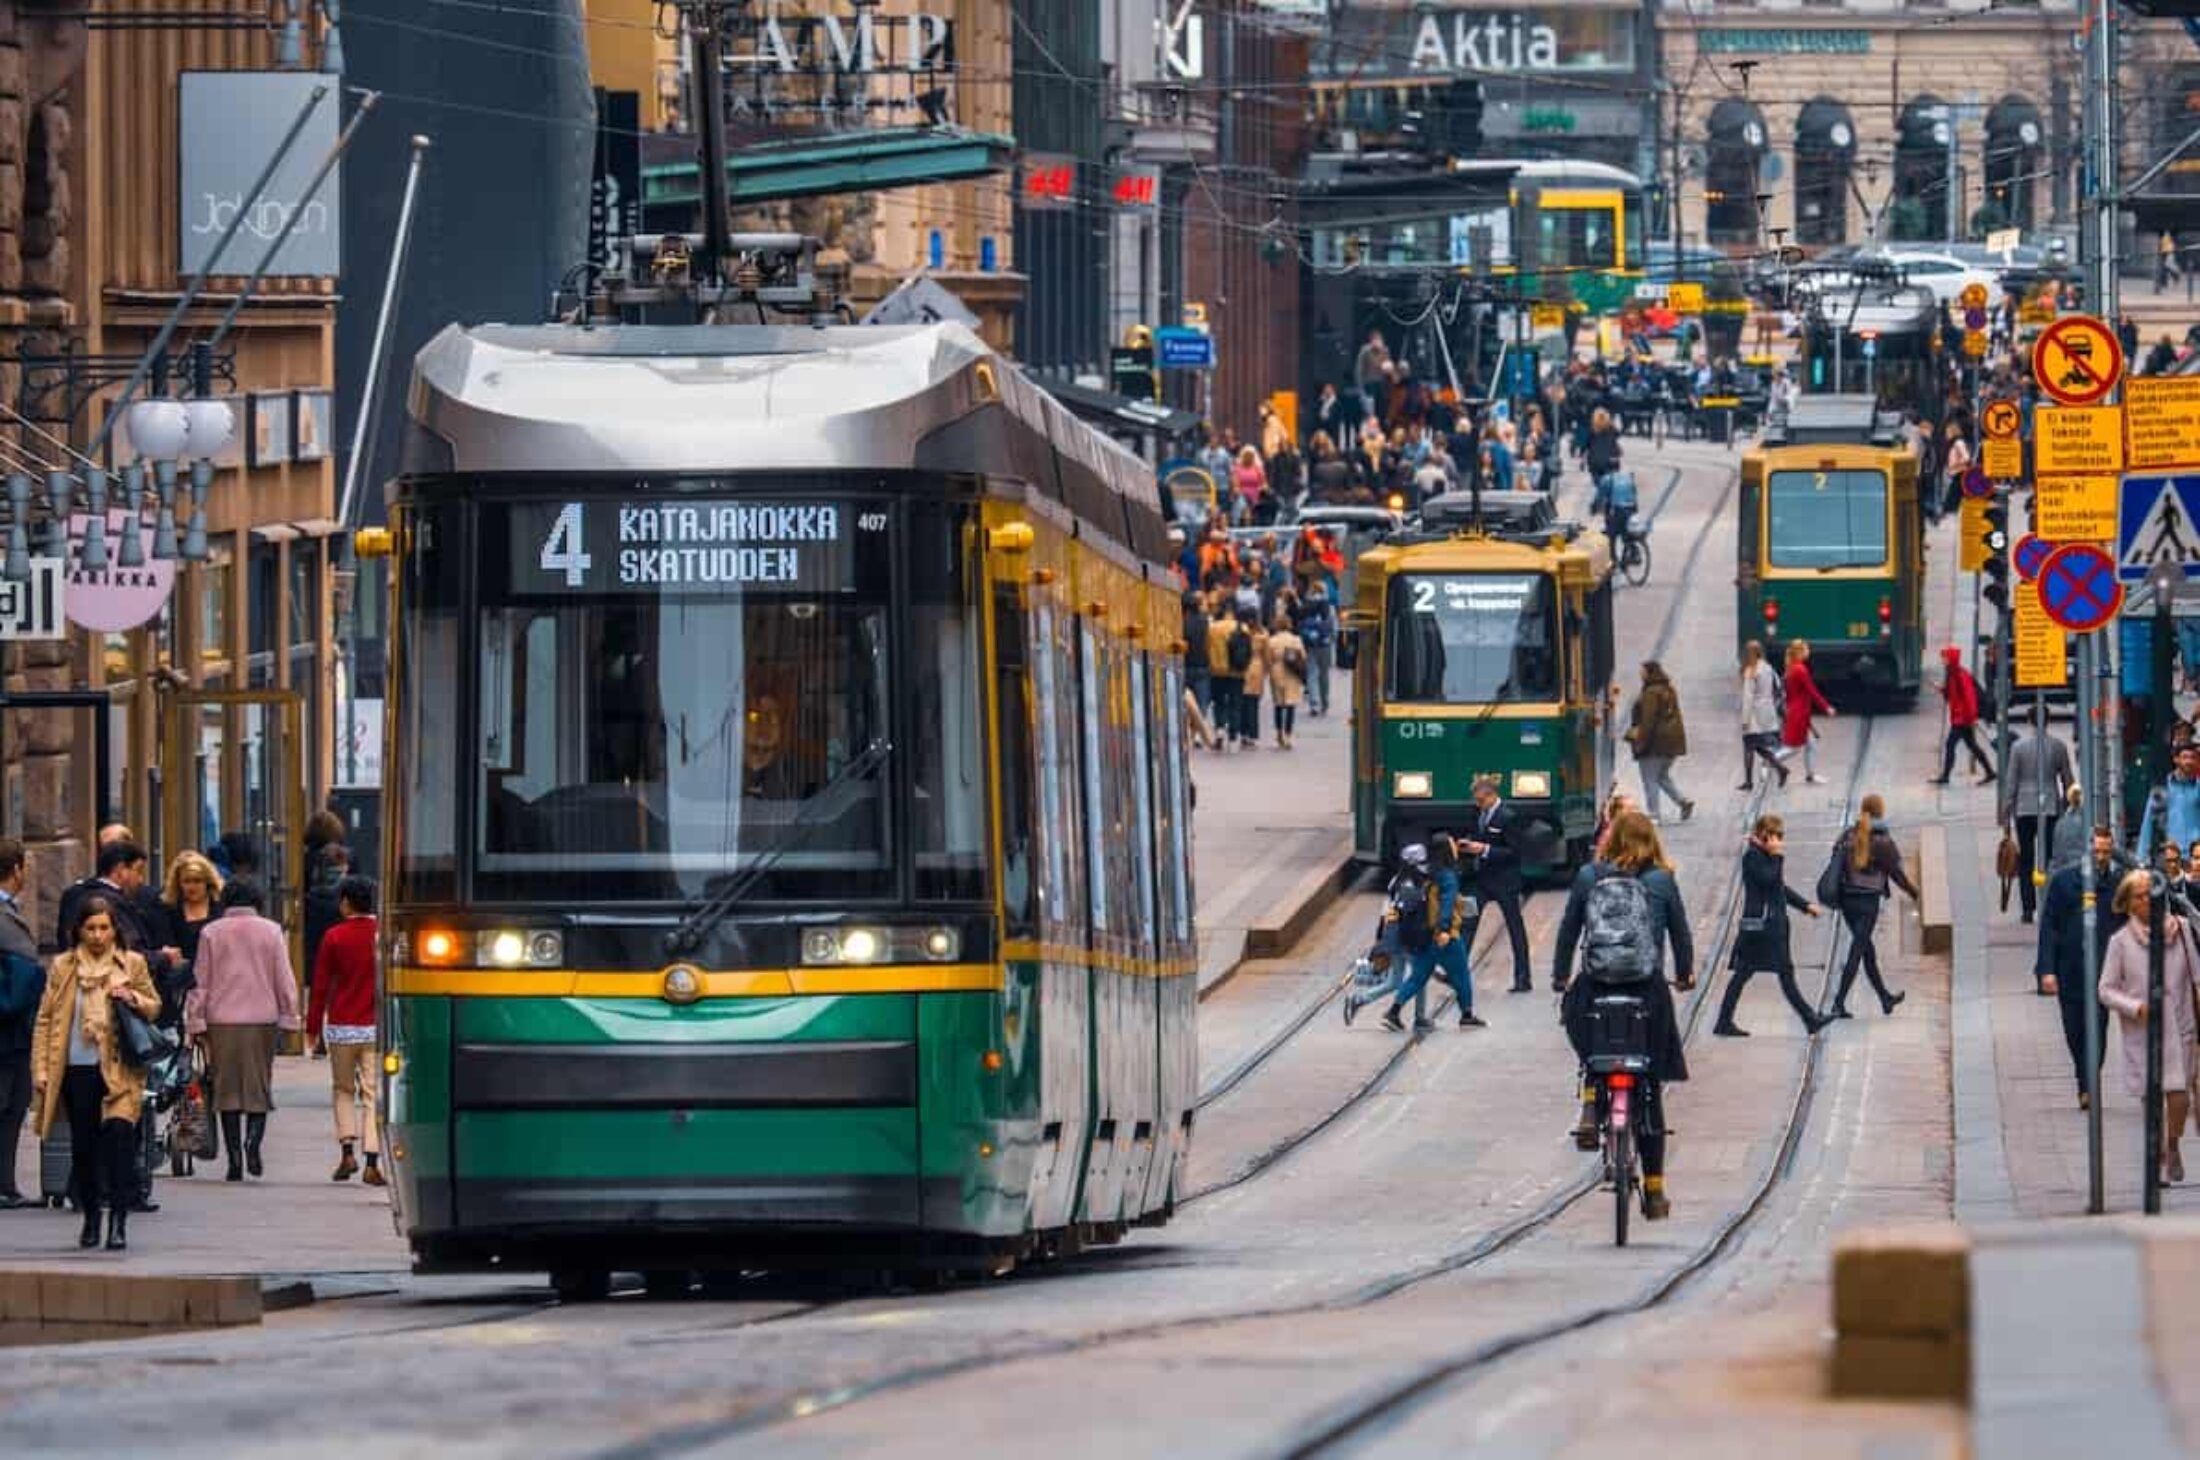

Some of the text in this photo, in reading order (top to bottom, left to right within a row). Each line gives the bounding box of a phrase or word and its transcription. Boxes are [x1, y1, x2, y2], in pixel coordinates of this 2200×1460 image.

[1409, 14, 1558, 69] Aktia
[858, 513, 887, 531] 407
[541, 503, 837, 586] 4 KATAJANOKKA
[619, 548, 798, 582] SKATUDDEN
[1414, 581, 1436, 613] 2
